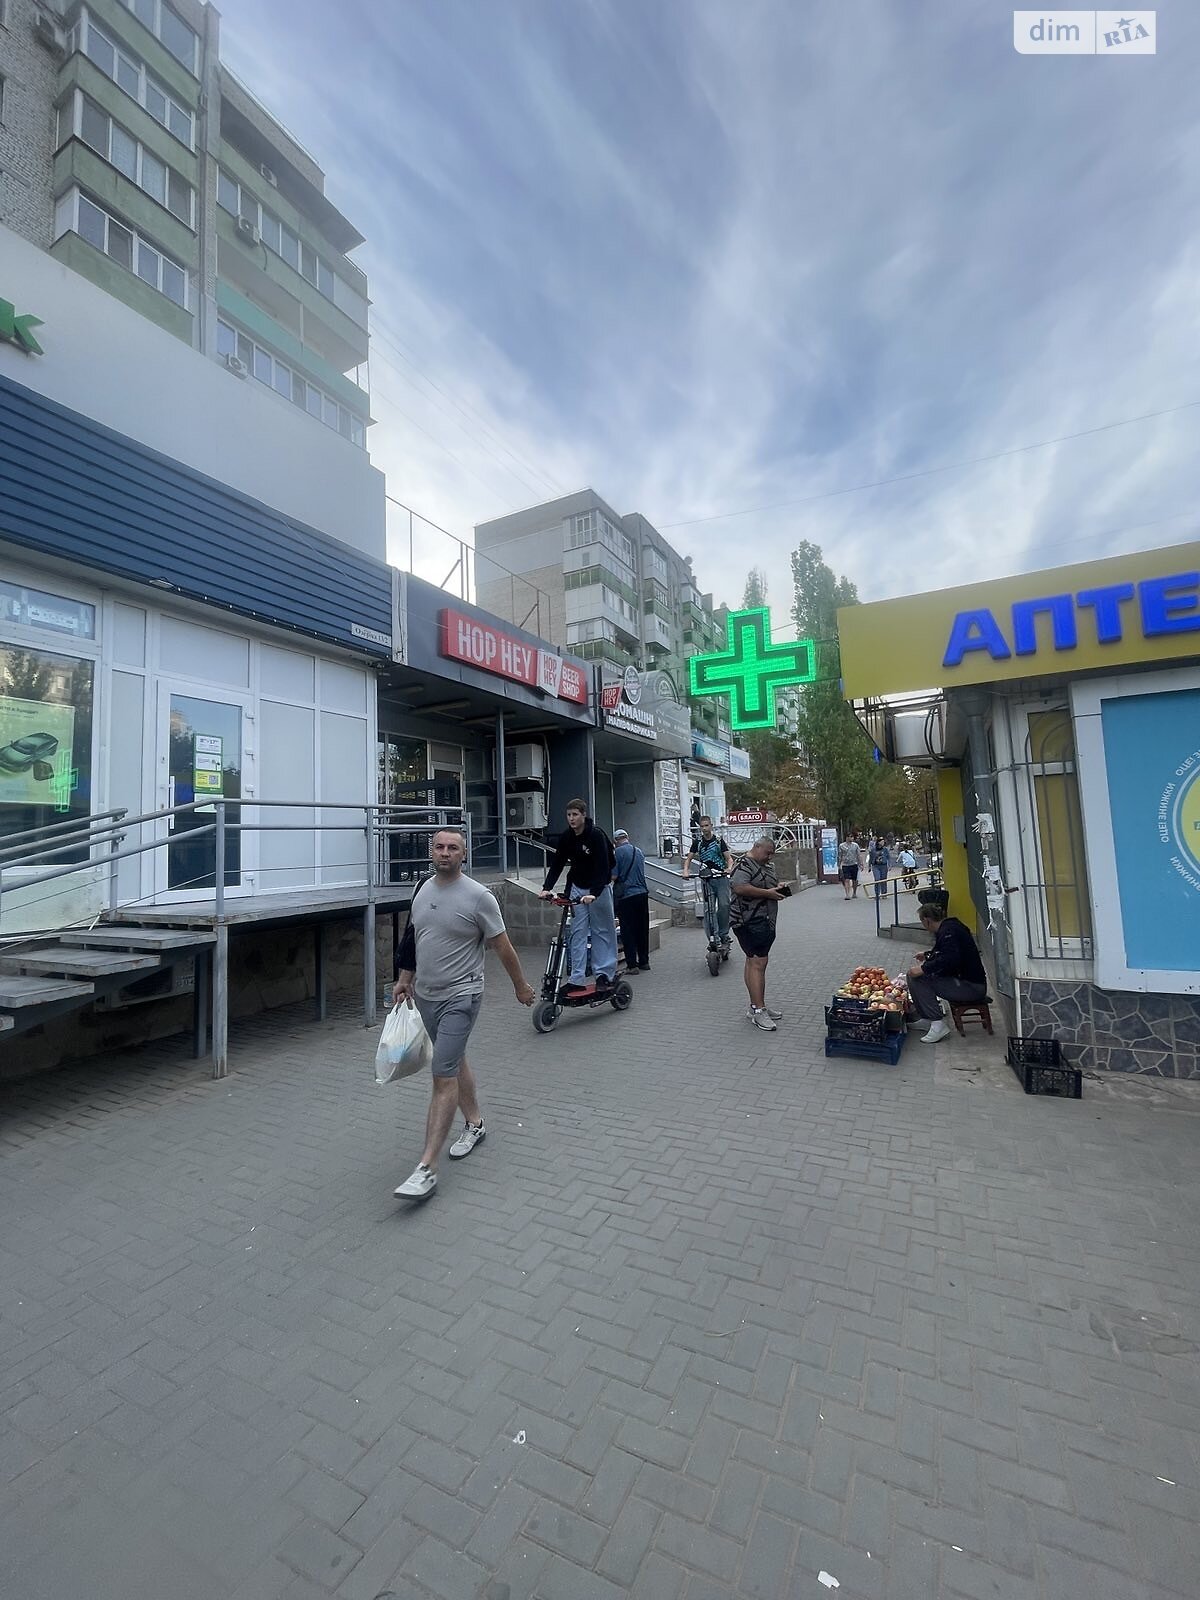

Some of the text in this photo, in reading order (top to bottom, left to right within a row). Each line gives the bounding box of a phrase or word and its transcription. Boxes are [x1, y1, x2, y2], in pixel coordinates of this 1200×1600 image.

[457, 618, 533, 680] HOP HEY
[543, 654, 557, 673] HOP
[543, 668, 557, 687] HEY
[562, 666, 579, 686] BEER
[562, 680, 580, 699] SHOP
[604, 689, 617, 697] HOP
[604, 696, 617, 705] HEY
[1158, 782, 1176, 820] ЗНИЖКИ
